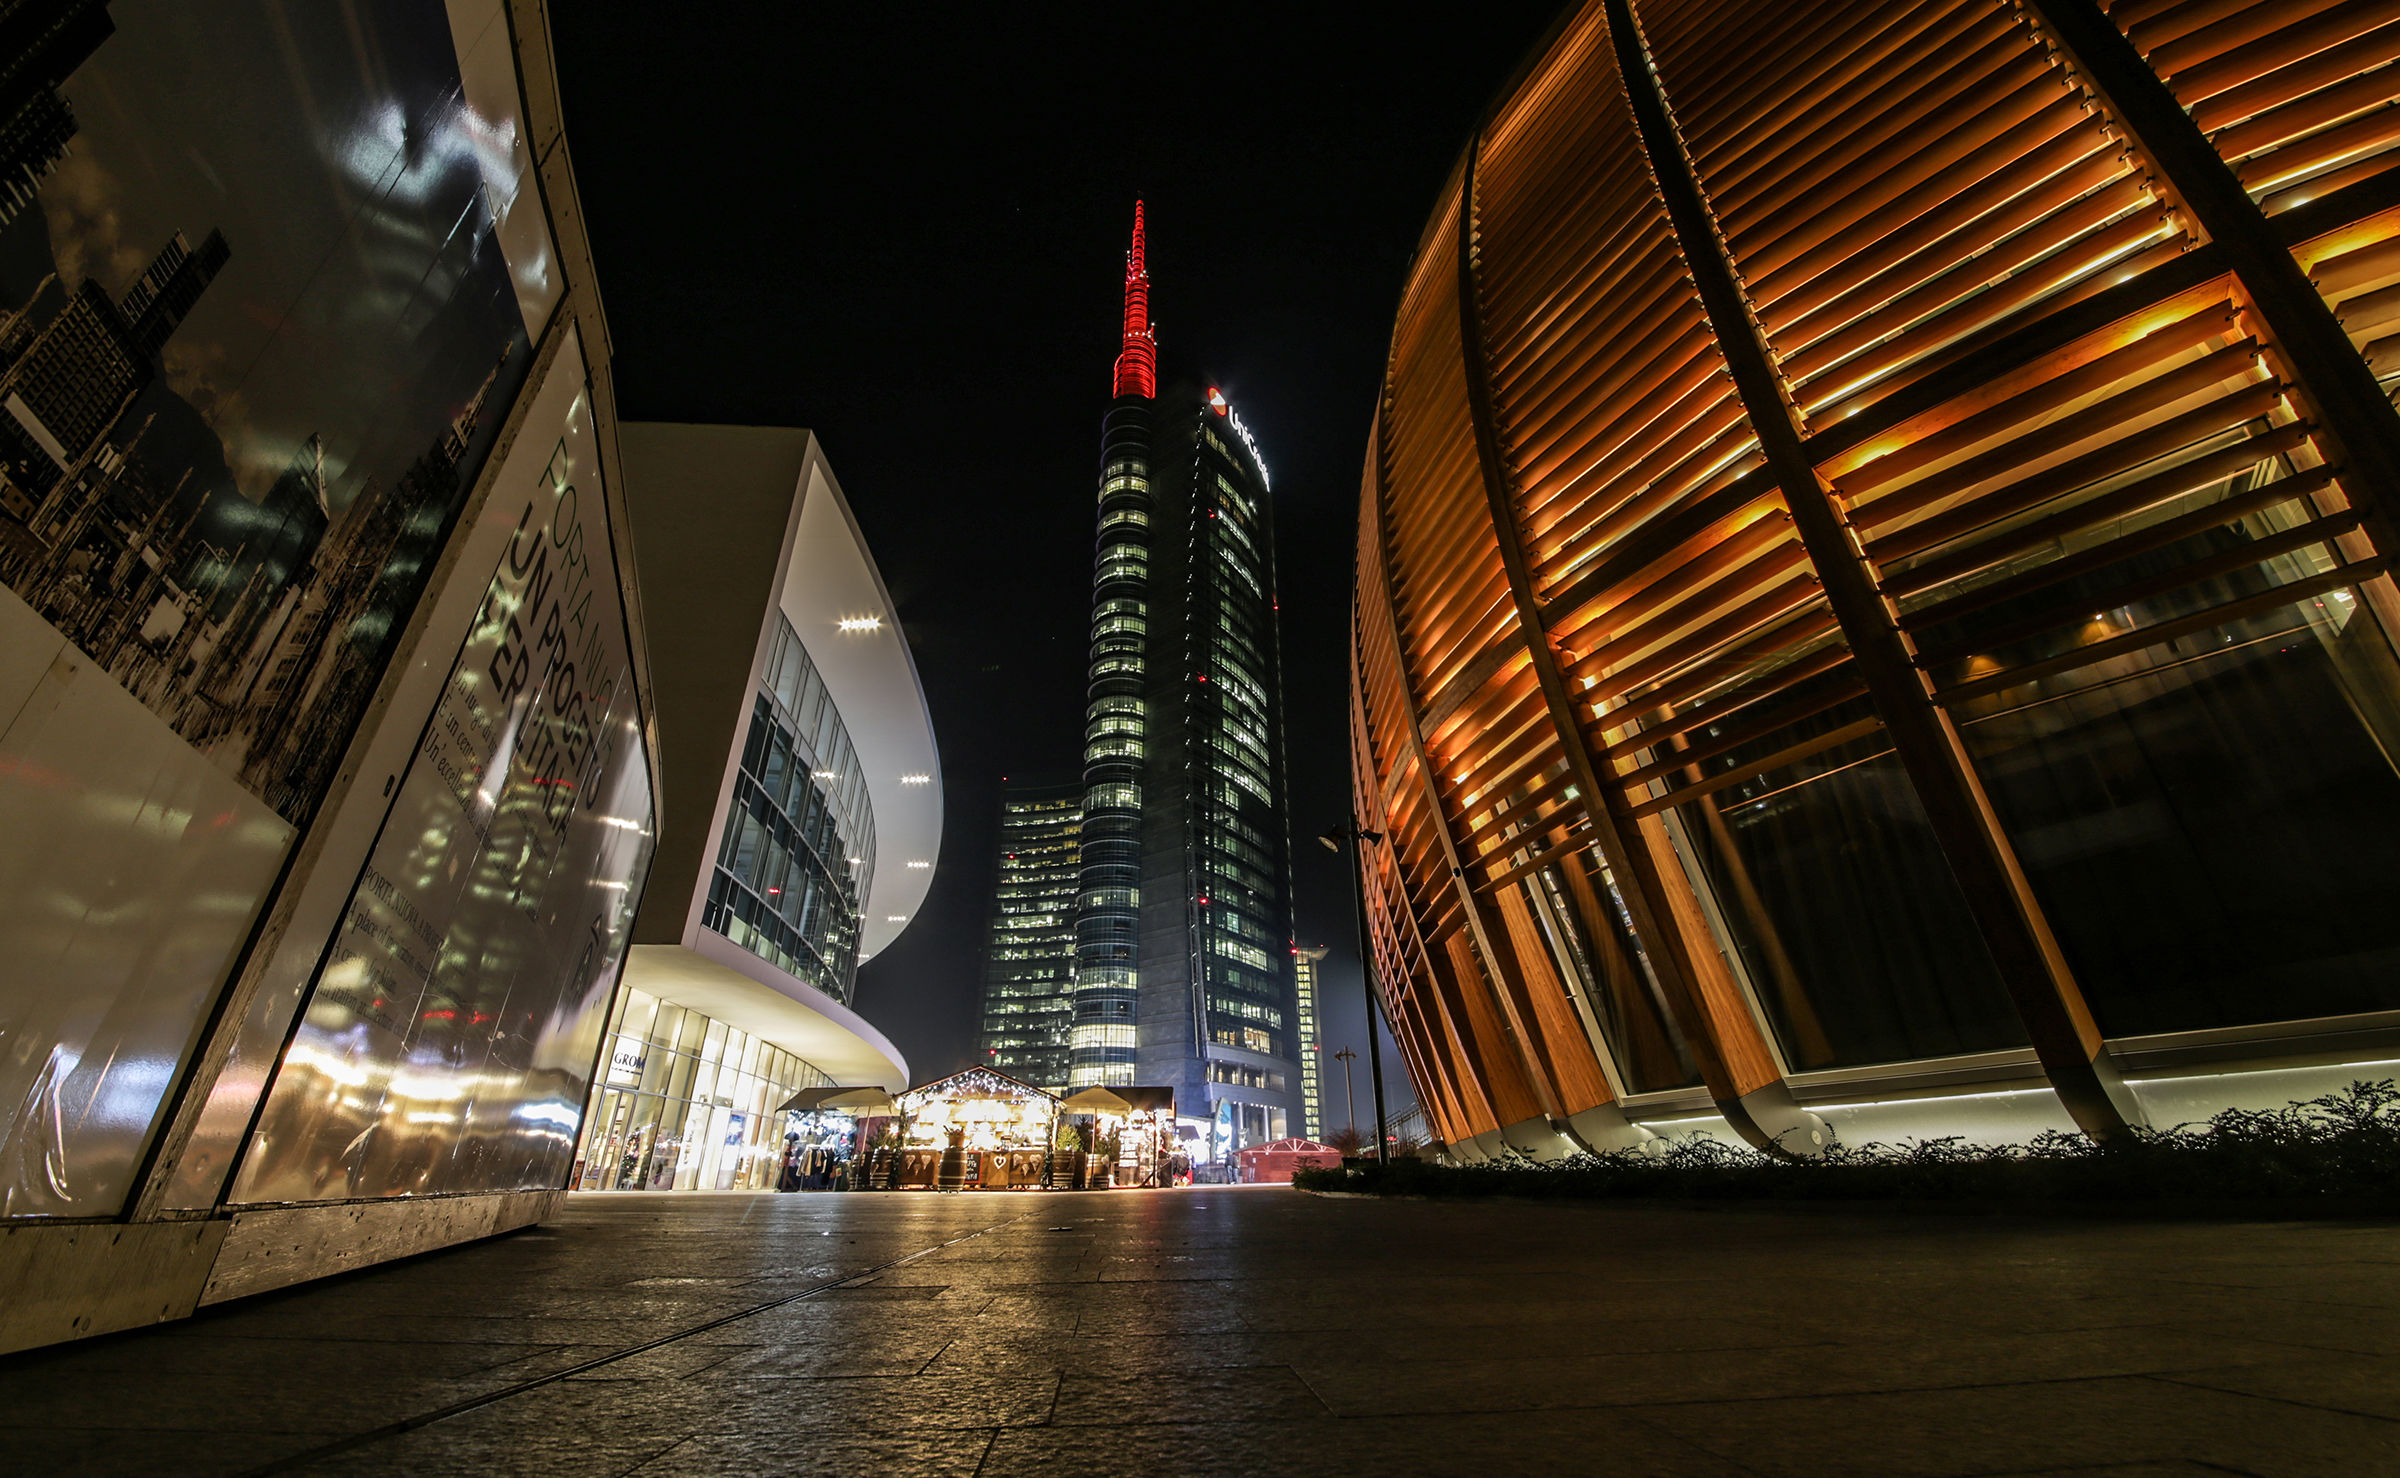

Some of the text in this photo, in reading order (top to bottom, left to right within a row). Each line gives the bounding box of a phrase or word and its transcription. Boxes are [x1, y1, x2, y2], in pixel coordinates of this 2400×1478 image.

[538, 436, 593, 648] PORTA
[473, 574, 530, 722] PER
[510, 500, 602, 810] UN PROGETTO
[445, 712, 459, 736] un
[614, 1052, 646, 1070] GROM
